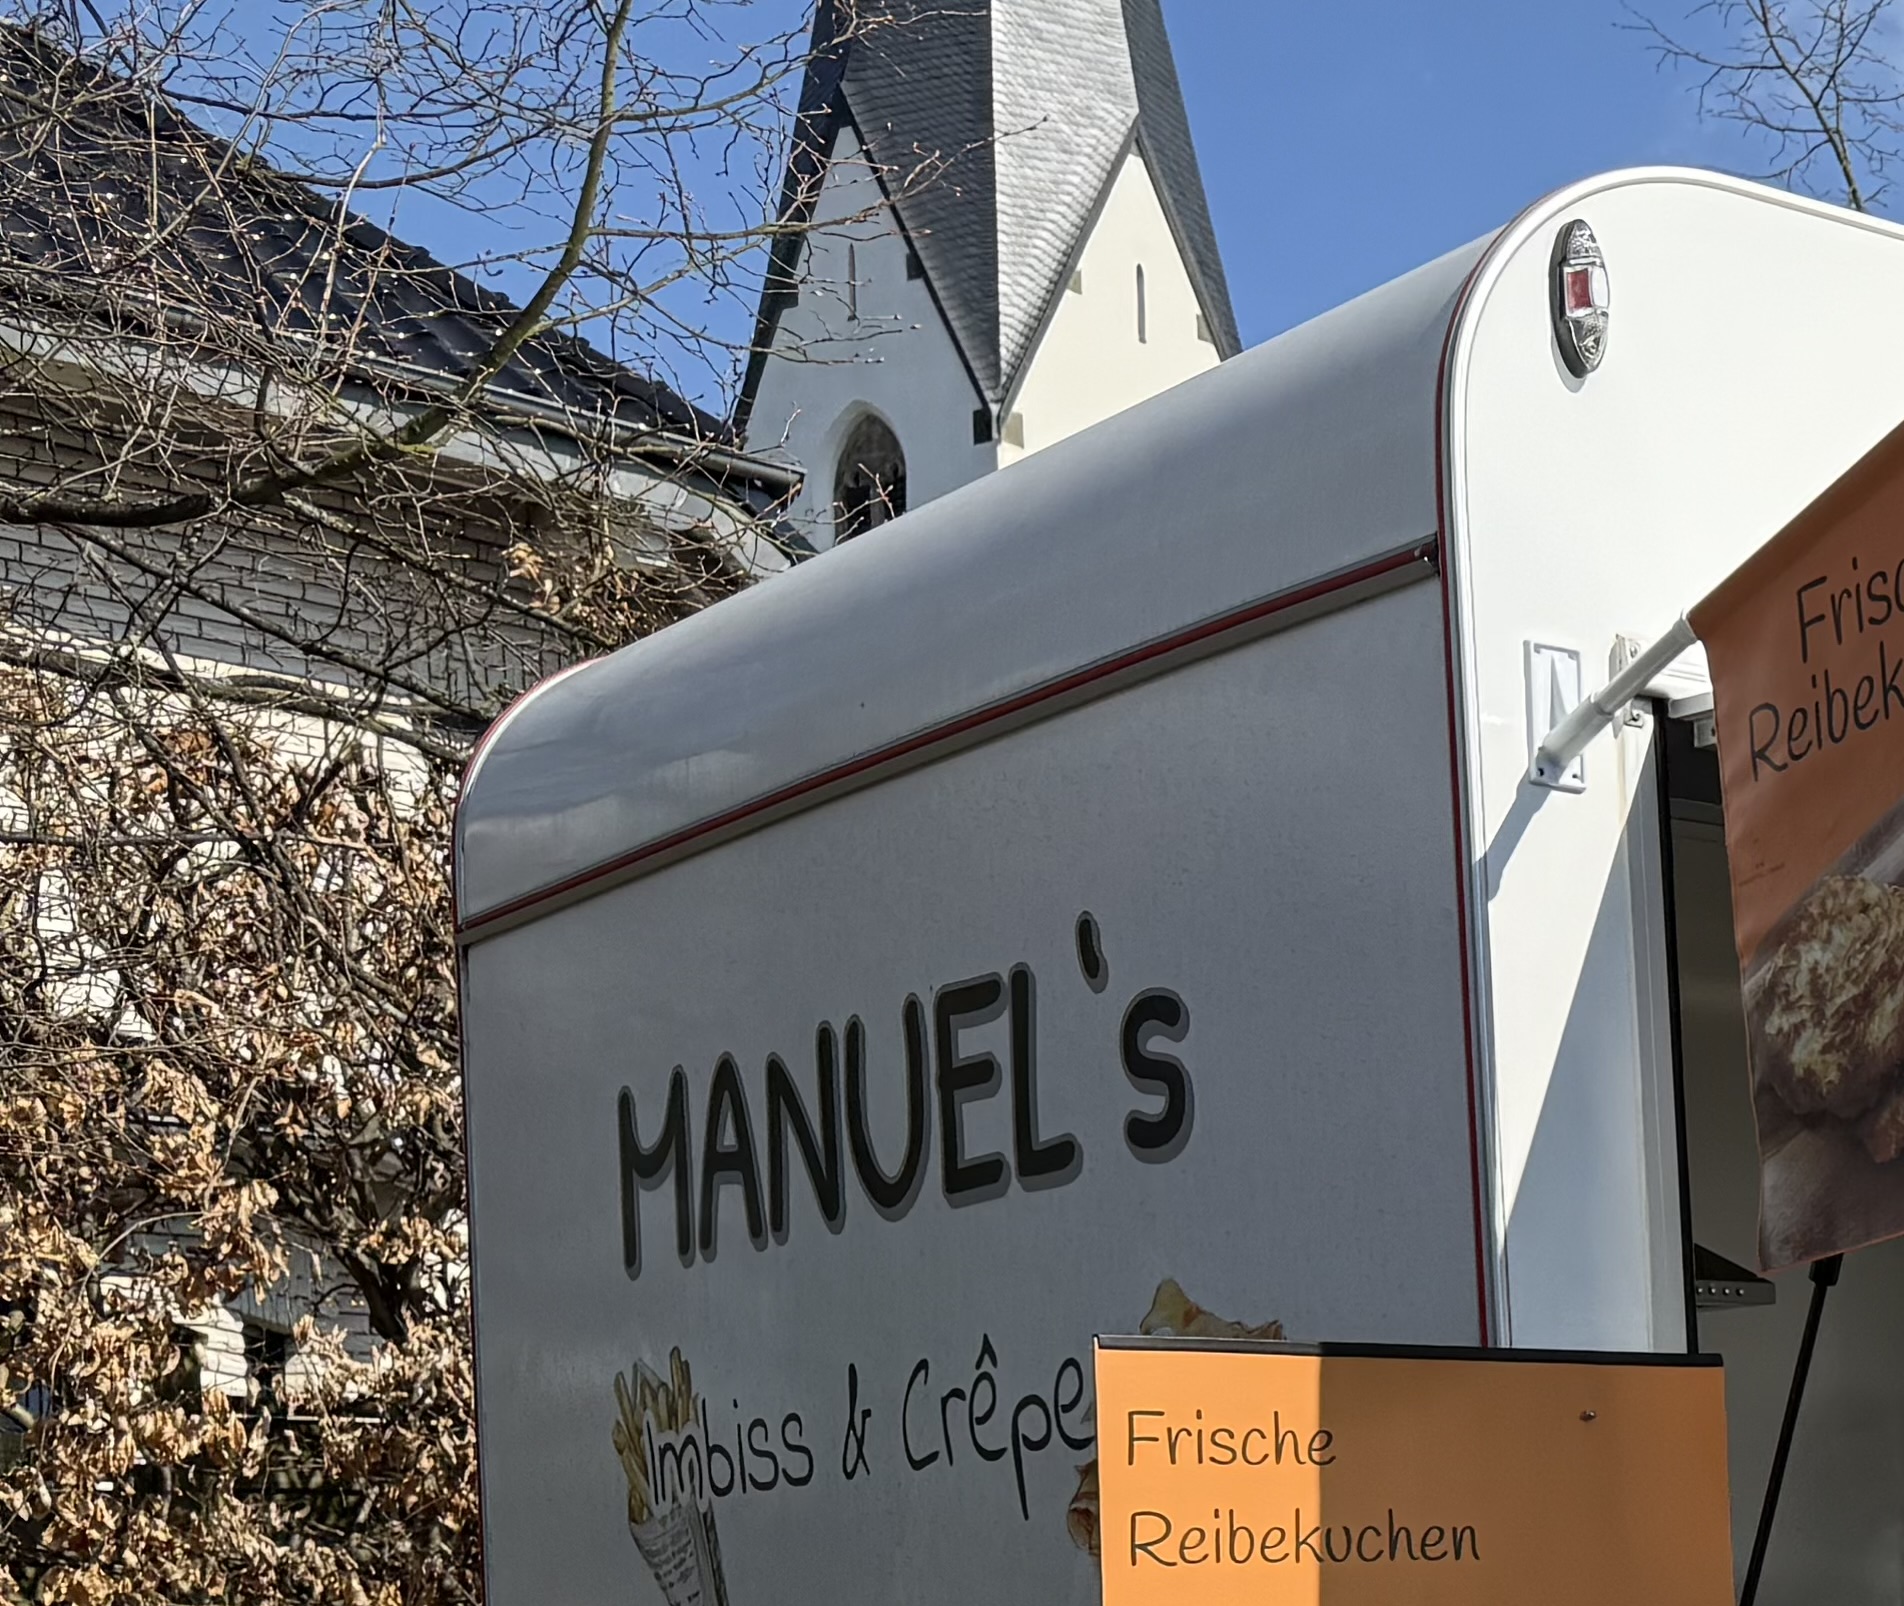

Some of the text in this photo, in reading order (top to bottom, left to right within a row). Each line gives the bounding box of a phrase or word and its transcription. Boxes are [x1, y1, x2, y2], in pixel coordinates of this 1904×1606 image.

[643, 1393, 815, 1506] Imbiss
[841, 1362, 872, 1481] &
[1126, 1410, 1337, 1467] Frische
[1128, 1508, 1481, 1568] Reibekuchen
